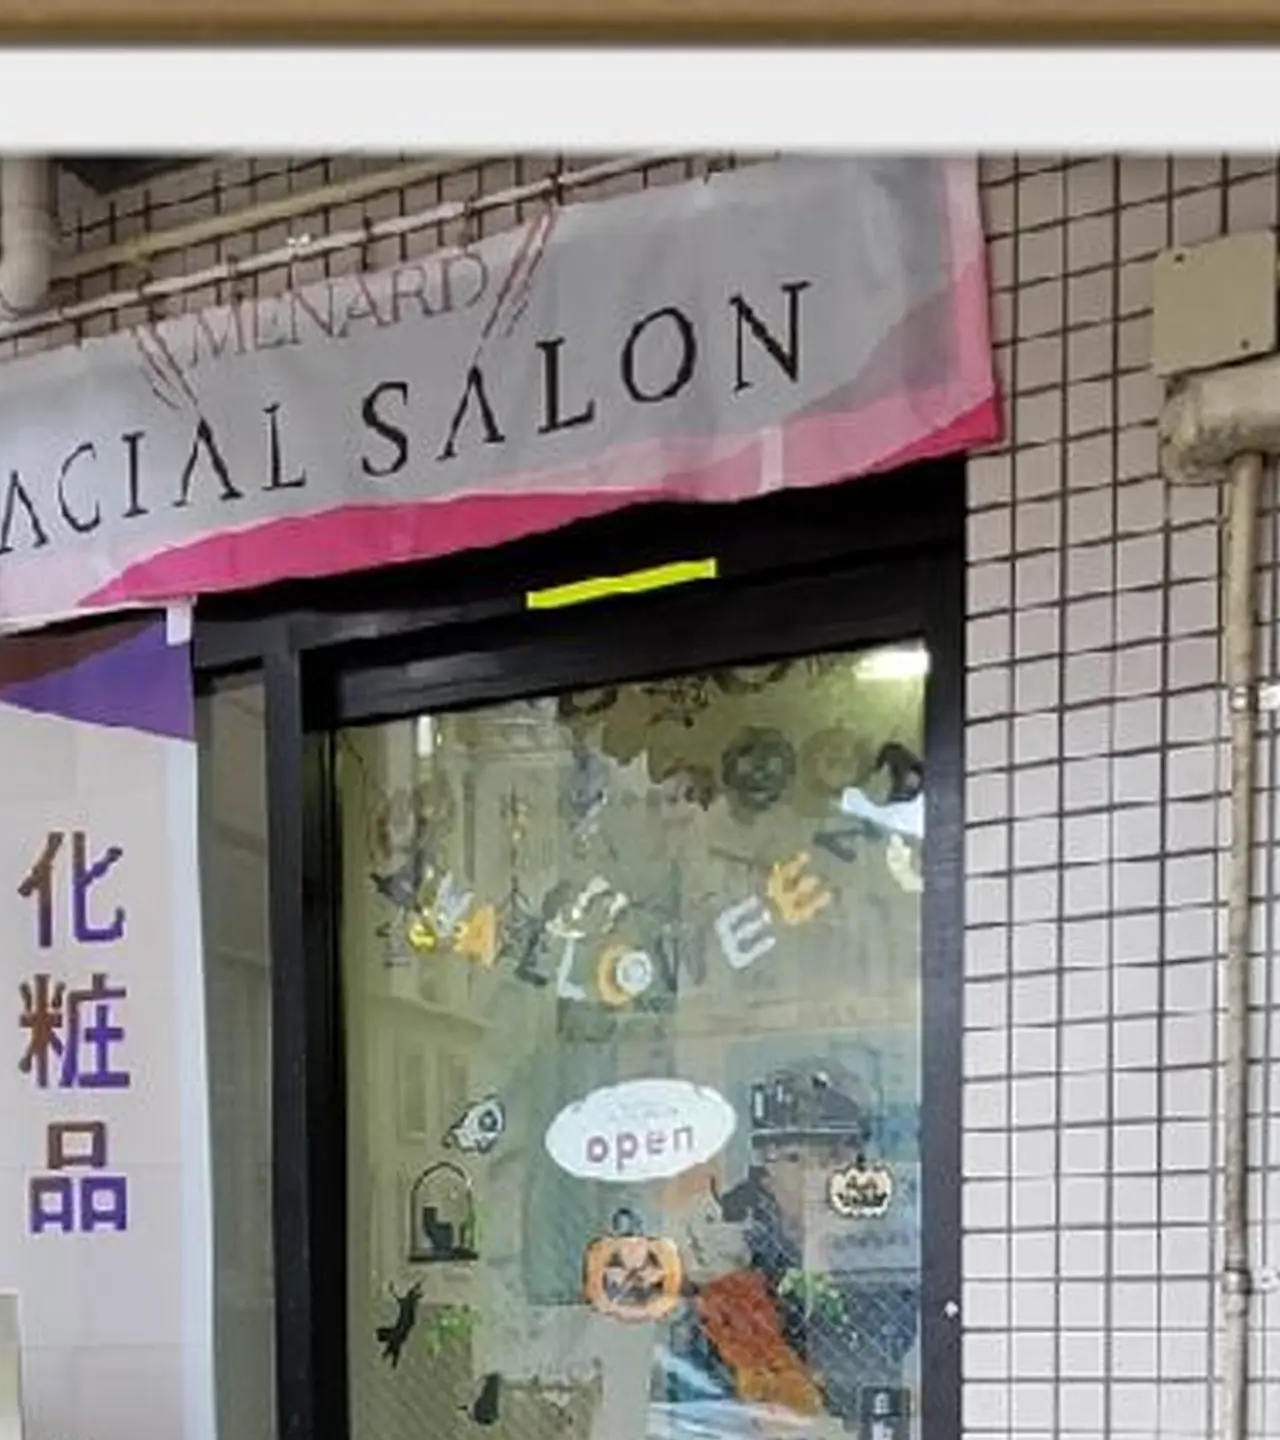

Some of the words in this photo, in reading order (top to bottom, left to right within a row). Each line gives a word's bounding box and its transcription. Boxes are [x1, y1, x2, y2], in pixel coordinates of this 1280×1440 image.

[184, 250, 486, 368] MENARD
[360, 280, 814, 480] SALON
[18, 830, 132, 1235] 化粧品
[586, 1124, 695, 1176] open
